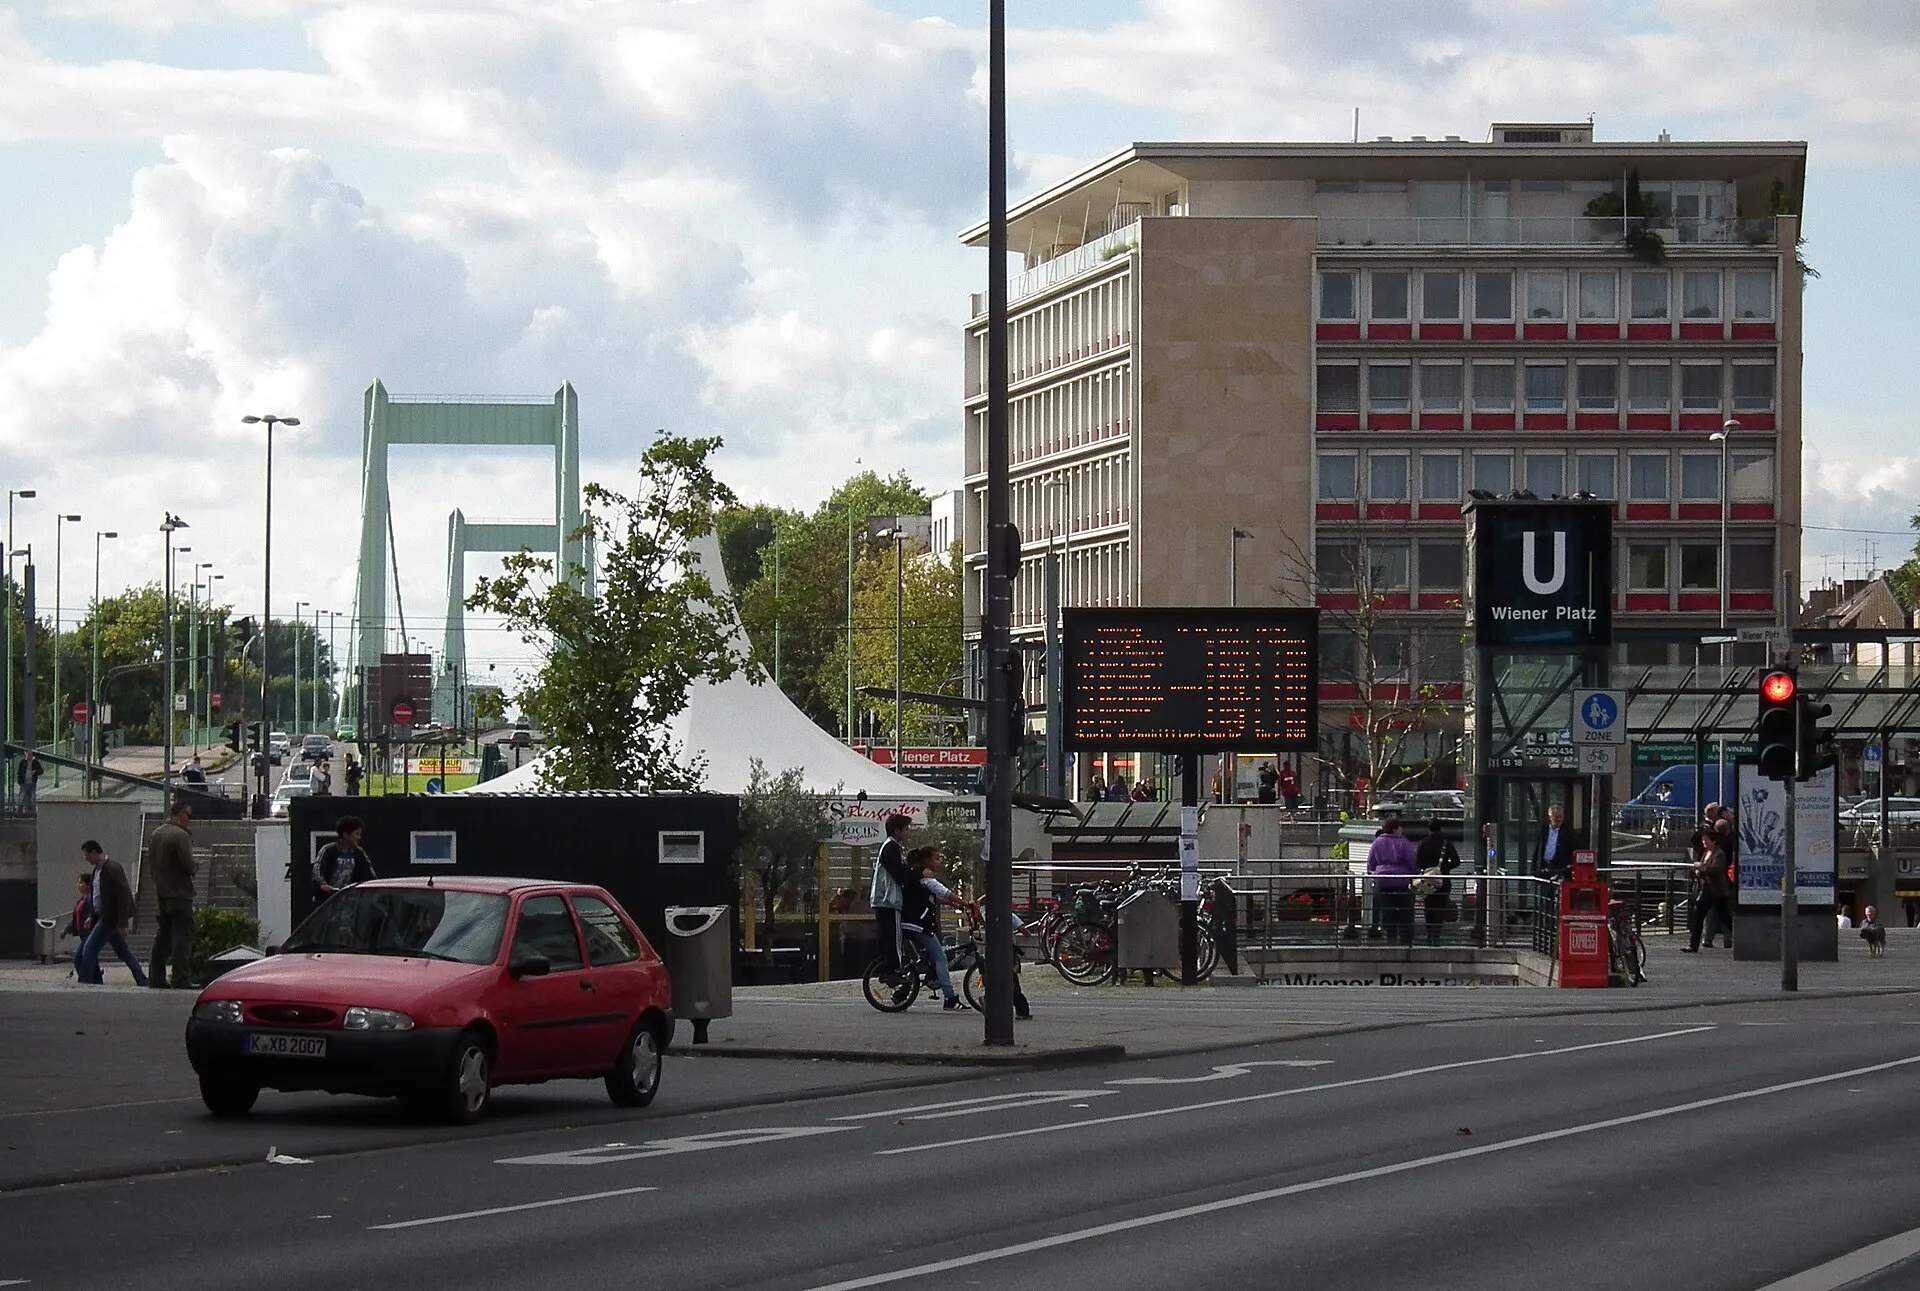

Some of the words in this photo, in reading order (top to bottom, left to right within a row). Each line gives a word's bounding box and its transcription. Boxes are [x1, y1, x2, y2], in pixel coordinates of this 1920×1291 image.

[1522, 531, 1566, 595] U
[1491, 606, 1548, 620] Wiener
[1556, 606, 1596, 620] Platz
[1585, 731, 1612, 741] ZONE
[889, 750, 935, 763] Wiener
[939, 750, 970, 763] Platz
[1502, 759, 1511, 767] 13
[1513, 759, 1523, 767] 18
[848, 802, 921, 821] Biergarten
[946, 806, 976, 818] Gilden
[1573, 933, 1596, 949] EXPRESS
[290, 1038, 325, 1054] 2007
